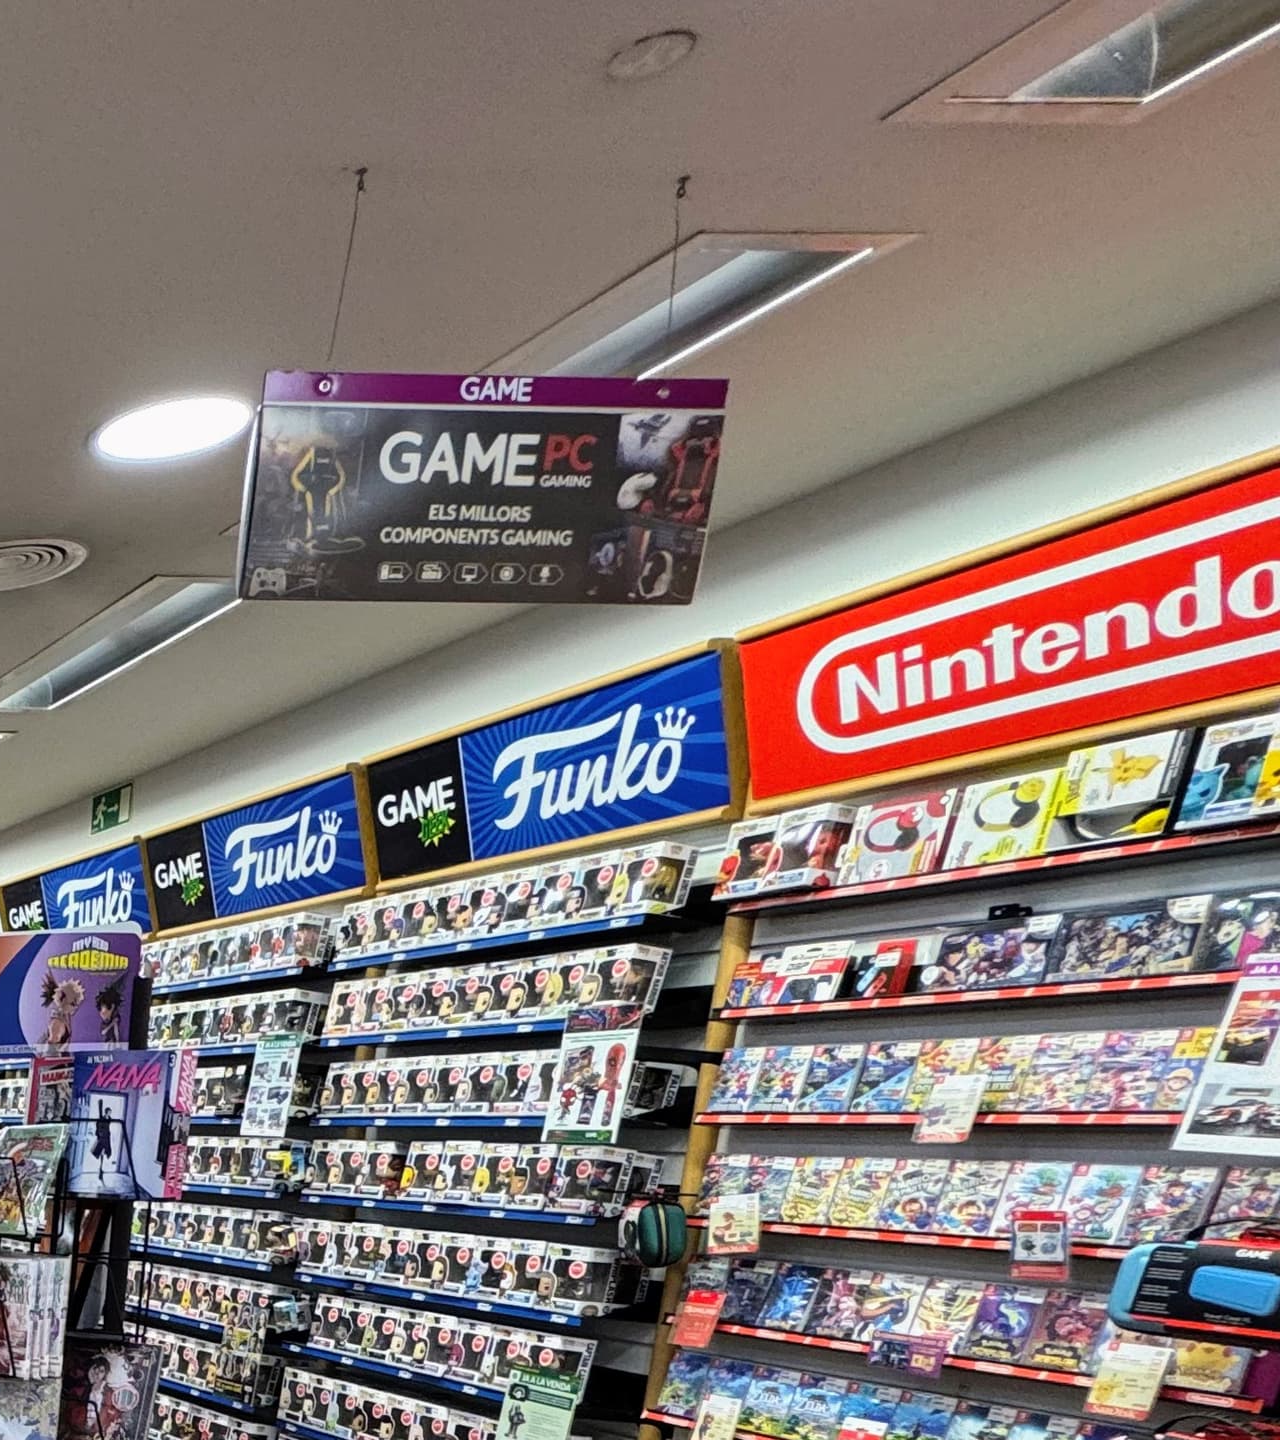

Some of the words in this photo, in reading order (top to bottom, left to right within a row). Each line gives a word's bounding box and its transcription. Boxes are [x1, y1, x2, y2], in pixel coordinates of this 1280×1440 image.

[460, 377, 534, 402] GAME
[379, 431, 540, 487] GAME
[543, 434, 597, 472] PC
[540, 474, 591, 488] GAMING
[429, 504, 456, 521] ELS
[459, 504, 531, 522] MILLORS
[379, 526, 499, 545] COMPONENTS
[502, 529, 572, 547] GAMING
[836, 555, 1280, 725] Nintendo
[492, 704, 687, 830] Funko
[377, 777, 455, 827] GAME
[224, 807, 337, 896] Funko
[154, 852, 204, 886] GAME
[57, 868, 133, 927] Funko
[9, 900, 42, 930] GAME
[72, 937, 89, 951] MY
[48, 951, 129, 969] ACADEMIA
[169, 1055, 176, 1067] 3
[84, 1062, 161, 1093] NANA
[1235, 1249, 1272, 1260] GAME
